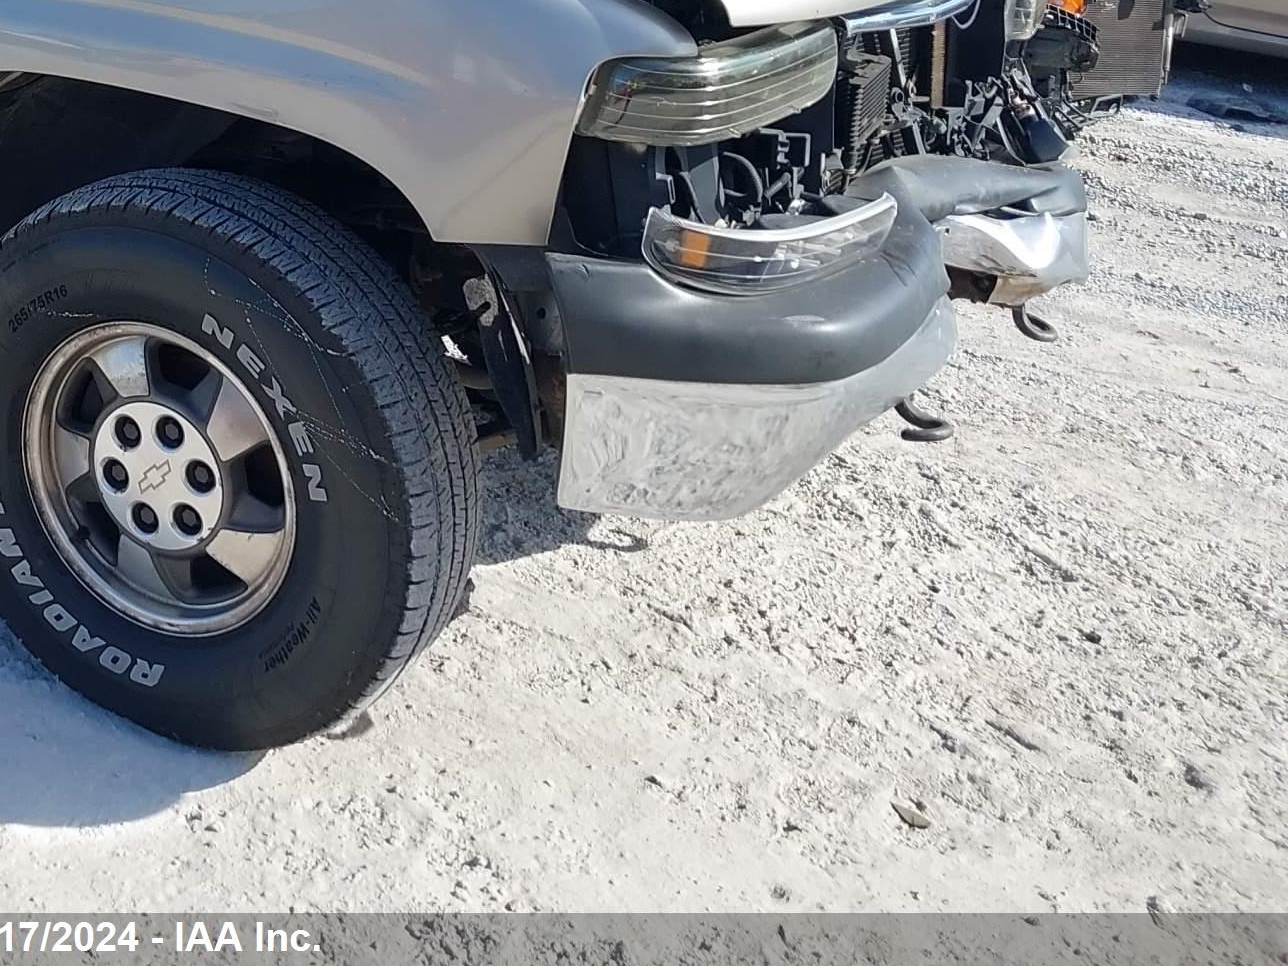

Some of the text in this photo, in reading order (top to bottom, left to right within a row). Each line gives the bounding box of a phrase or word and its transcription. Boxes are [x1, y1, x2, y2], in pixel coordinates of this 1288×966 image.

[8, 284, 68, 333] 265/75R16
[201, 313, 328, 502] NEXEN
[264, 596, 321, 673] All-Weather
